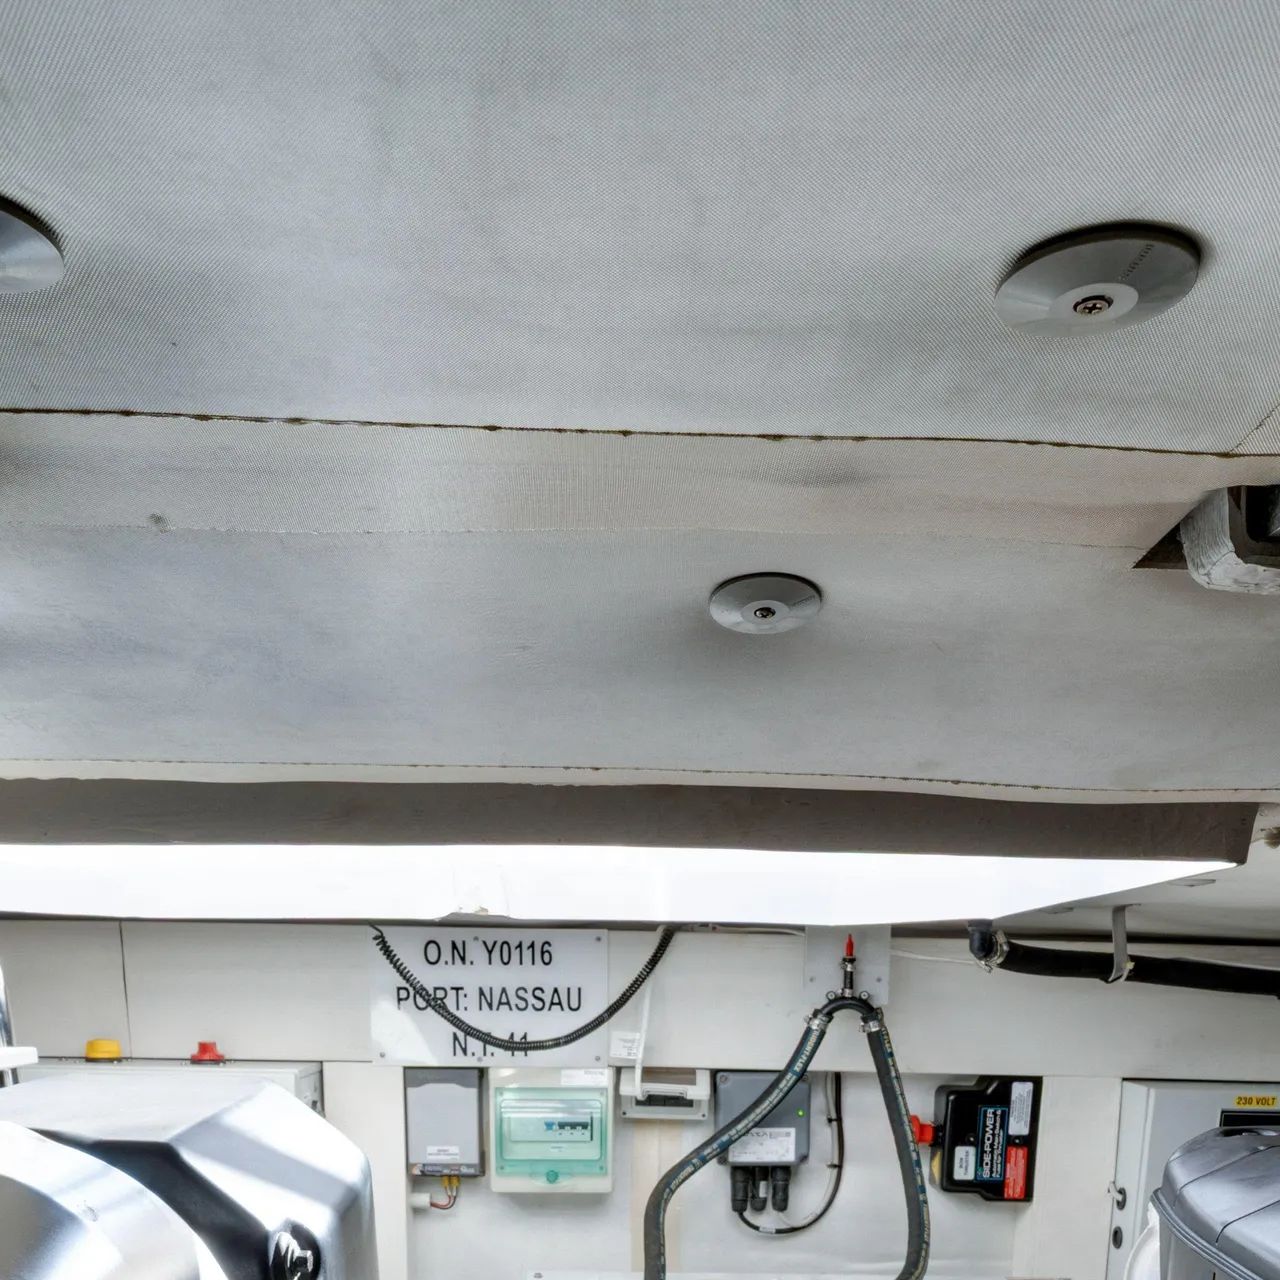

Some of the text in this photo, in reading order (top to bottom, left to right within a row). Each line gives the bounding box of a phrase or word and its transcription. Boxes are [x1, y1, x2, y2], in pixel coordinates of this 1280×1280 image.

[423, 940, 553, 966] O.N. Y0116
[396, 986, 582, 1012] PORT: NASSAU
[1236, 1096, 1277, 1106] 230 VOLT
[982, 1108, 995, 1178] SIDE-POWER
